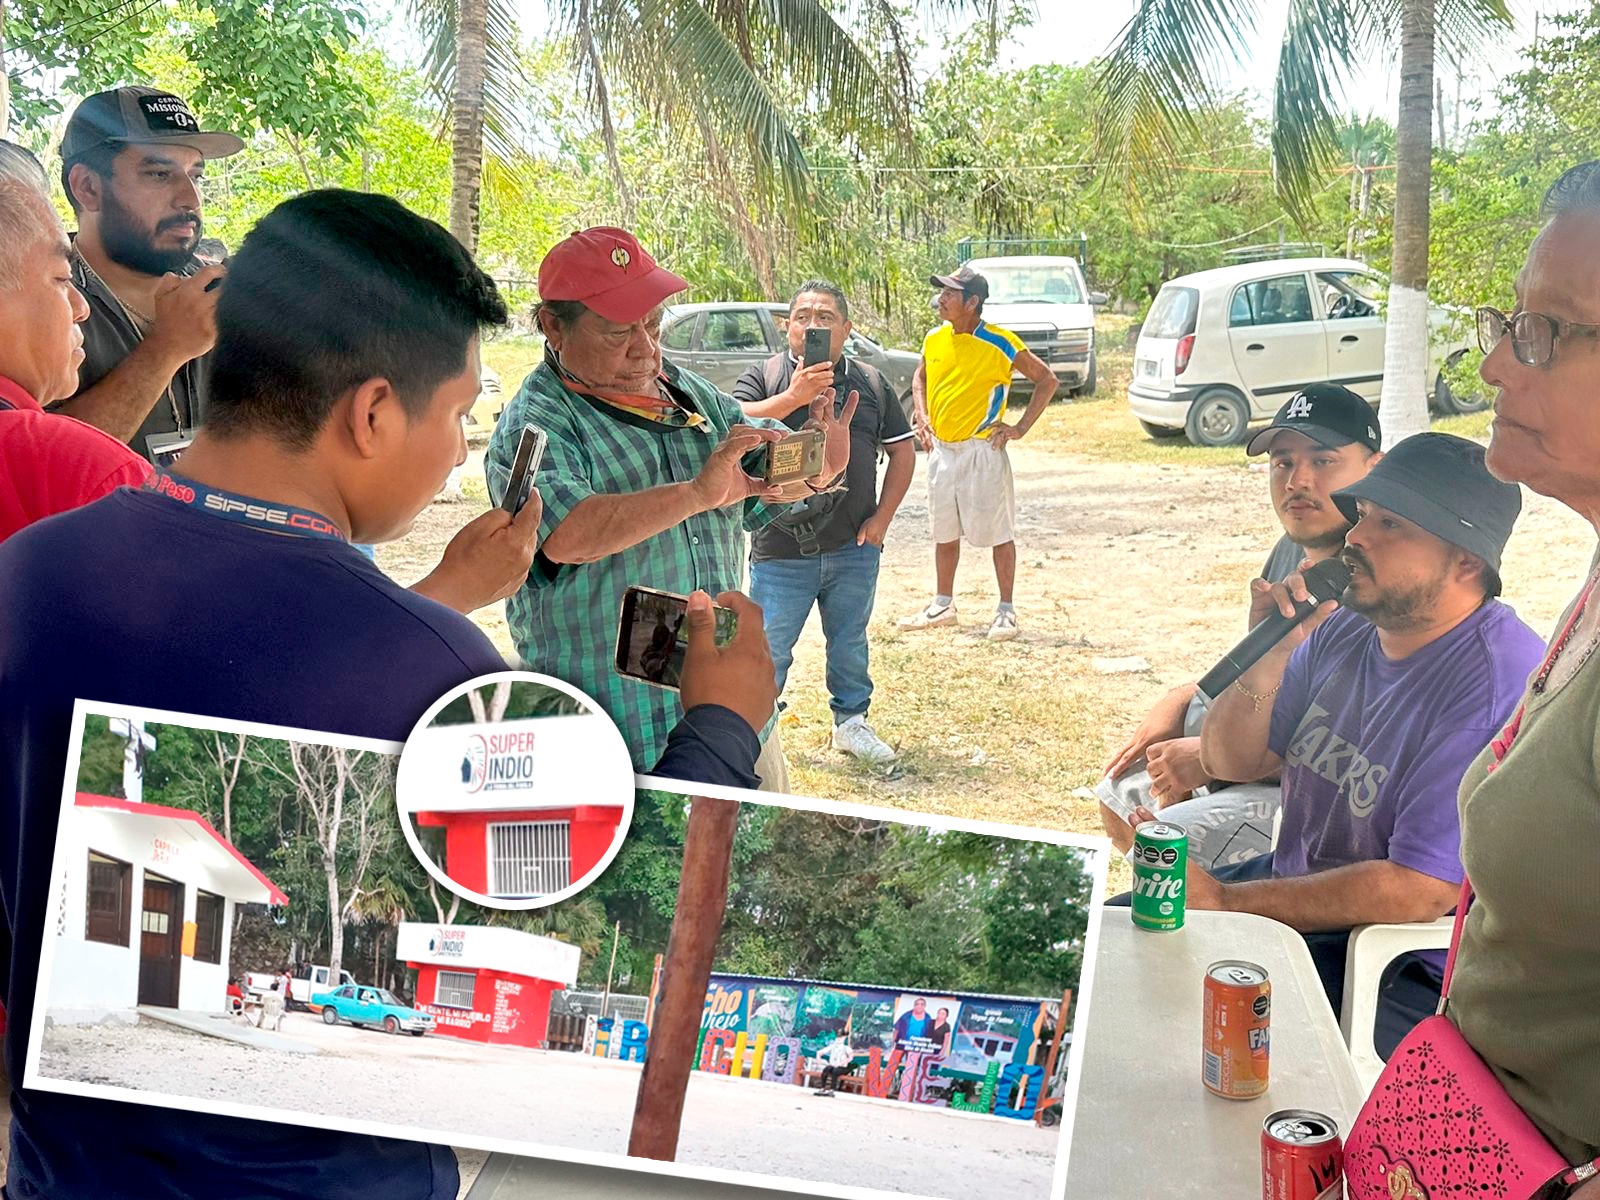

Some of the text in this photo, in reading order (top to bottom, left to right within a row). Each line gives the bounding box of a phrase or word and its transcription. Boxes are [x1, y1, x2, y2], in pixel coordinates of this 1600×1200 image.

[1286, 392, 1313, 419] LA
[157, 474, 196, 504] Peso
[489, 732, 535, 755] SUPER
[488, 754, 534, 781] INDIO
[441, 940, 464, 953] INDIO
[443, 929, 466, 941] SUPER
[461, 1009, 491, 1023] PUEBLO
